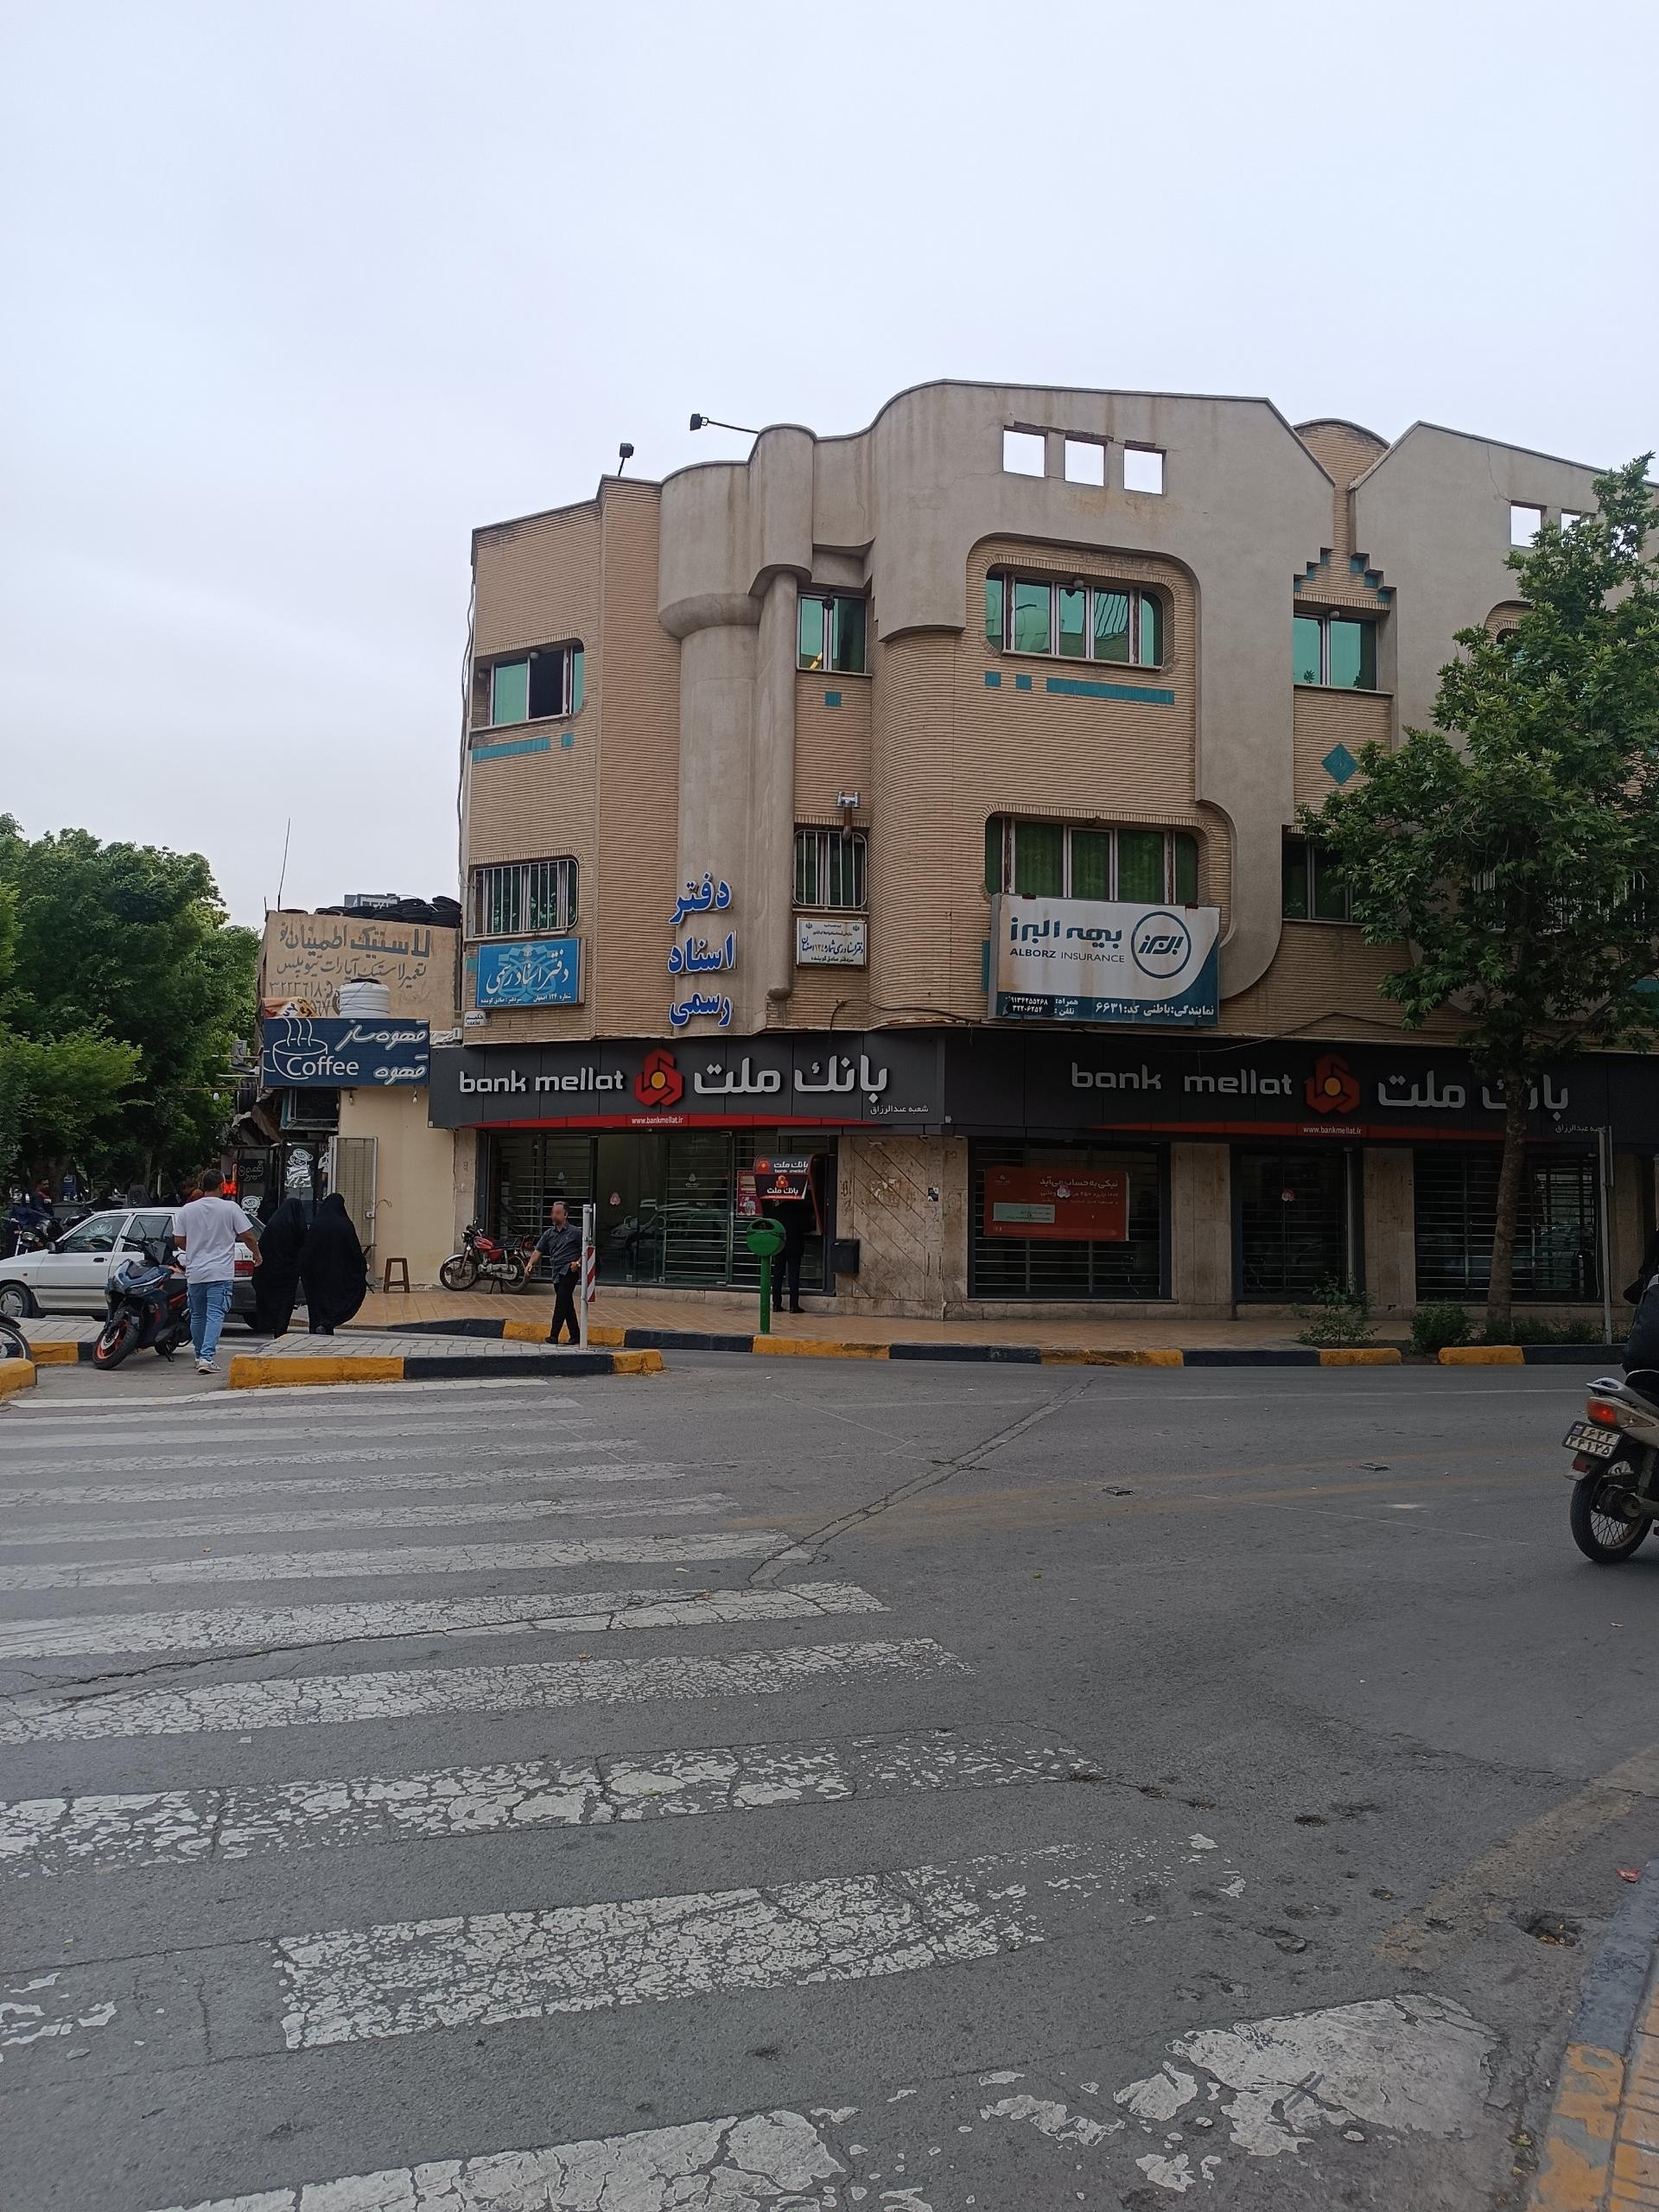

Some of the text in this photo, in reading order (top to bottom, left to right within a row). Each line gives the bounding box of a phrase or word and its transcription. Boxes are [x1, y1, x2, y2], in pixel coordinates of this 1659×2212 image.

[668, 872, 731, 925] دفتر
[285, 924, 347, 957] اطمینان
[350, 925, 430, 958] لاستیک
[1010, 917, 1122, 950] بیمه البرز
[667, 930, 734, 974] اسناد
[1009, 948, 1125, 963] ALBORZ INSURANCE
[398, 962, 427, 989] تعمیر
[486, 949, 569, 995] دفتر اسناد رسمی
[669, 992, 732, 1027] رسمی
[334, 1020, 429, 1052] قهوه ساز
[286, 1055, 360, 1076] Coffee
[372, 1054, 429, 1086] قهوه
[459, 1067, 624, 1094] bank mellat
[694, 1053, 887, 1103] بانک ملت
[1071, 1062, 1293, 1096] bank mellat
[1377, 1070, 1466, 1109] ملت
[631, 1116, 683, 1124] www.bankmellat.ir
[870, 1104, 929, 1116] شعبه عبدالرزاق
[1302, 1126, 1362, 1135] www.bankmellat.ir
[783, 1187, 799, 1197] بانک
